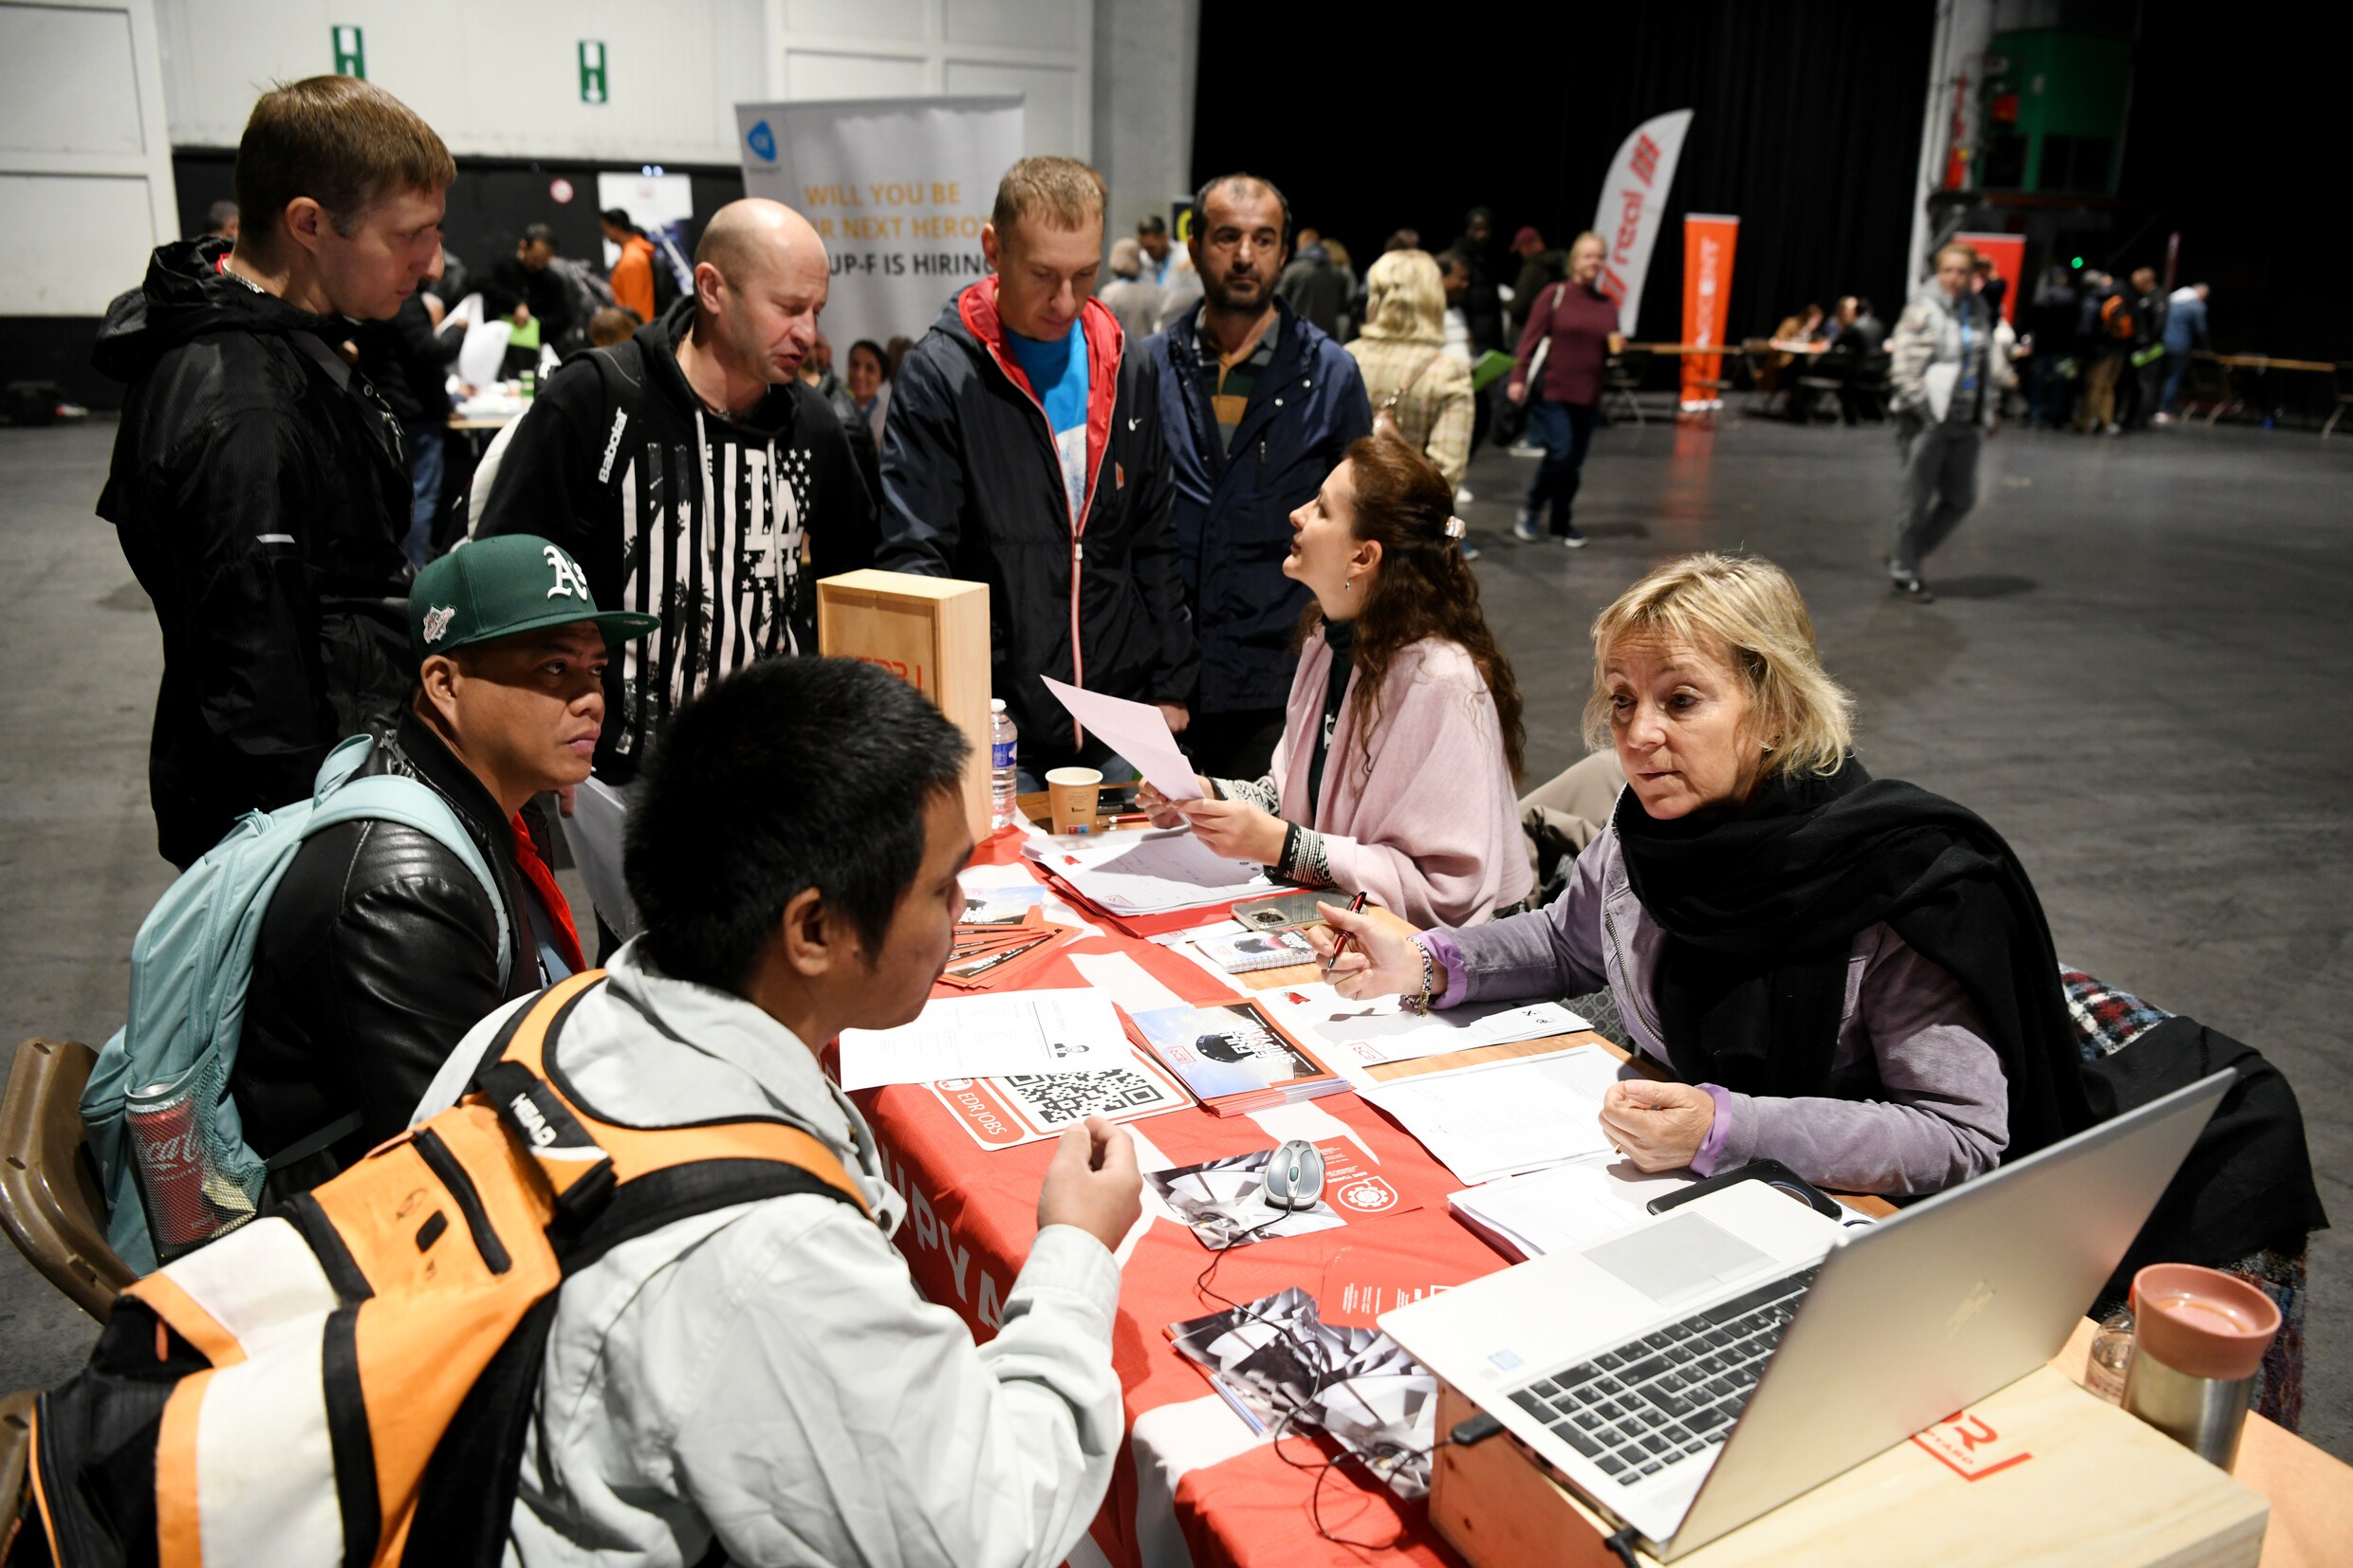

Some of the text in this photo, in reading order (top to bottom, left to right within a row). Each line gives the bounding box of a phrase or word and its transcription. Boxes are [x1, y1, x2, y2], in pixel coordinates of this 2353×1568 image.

[805, 182, 961, 207] WILL YOU BE
[841, 217, 902, 239] NEXT
[1613, 189, 1644, 266] real
[884, 253, 905, 275] IS
[598, 406, 629, 485] Babolat
[1238, 1018, 1297, 1064] SHIPYARD
[510, 1092, 557, 1147] HEAD
[956, 1092, 1009, 1136] EDR JOBS
